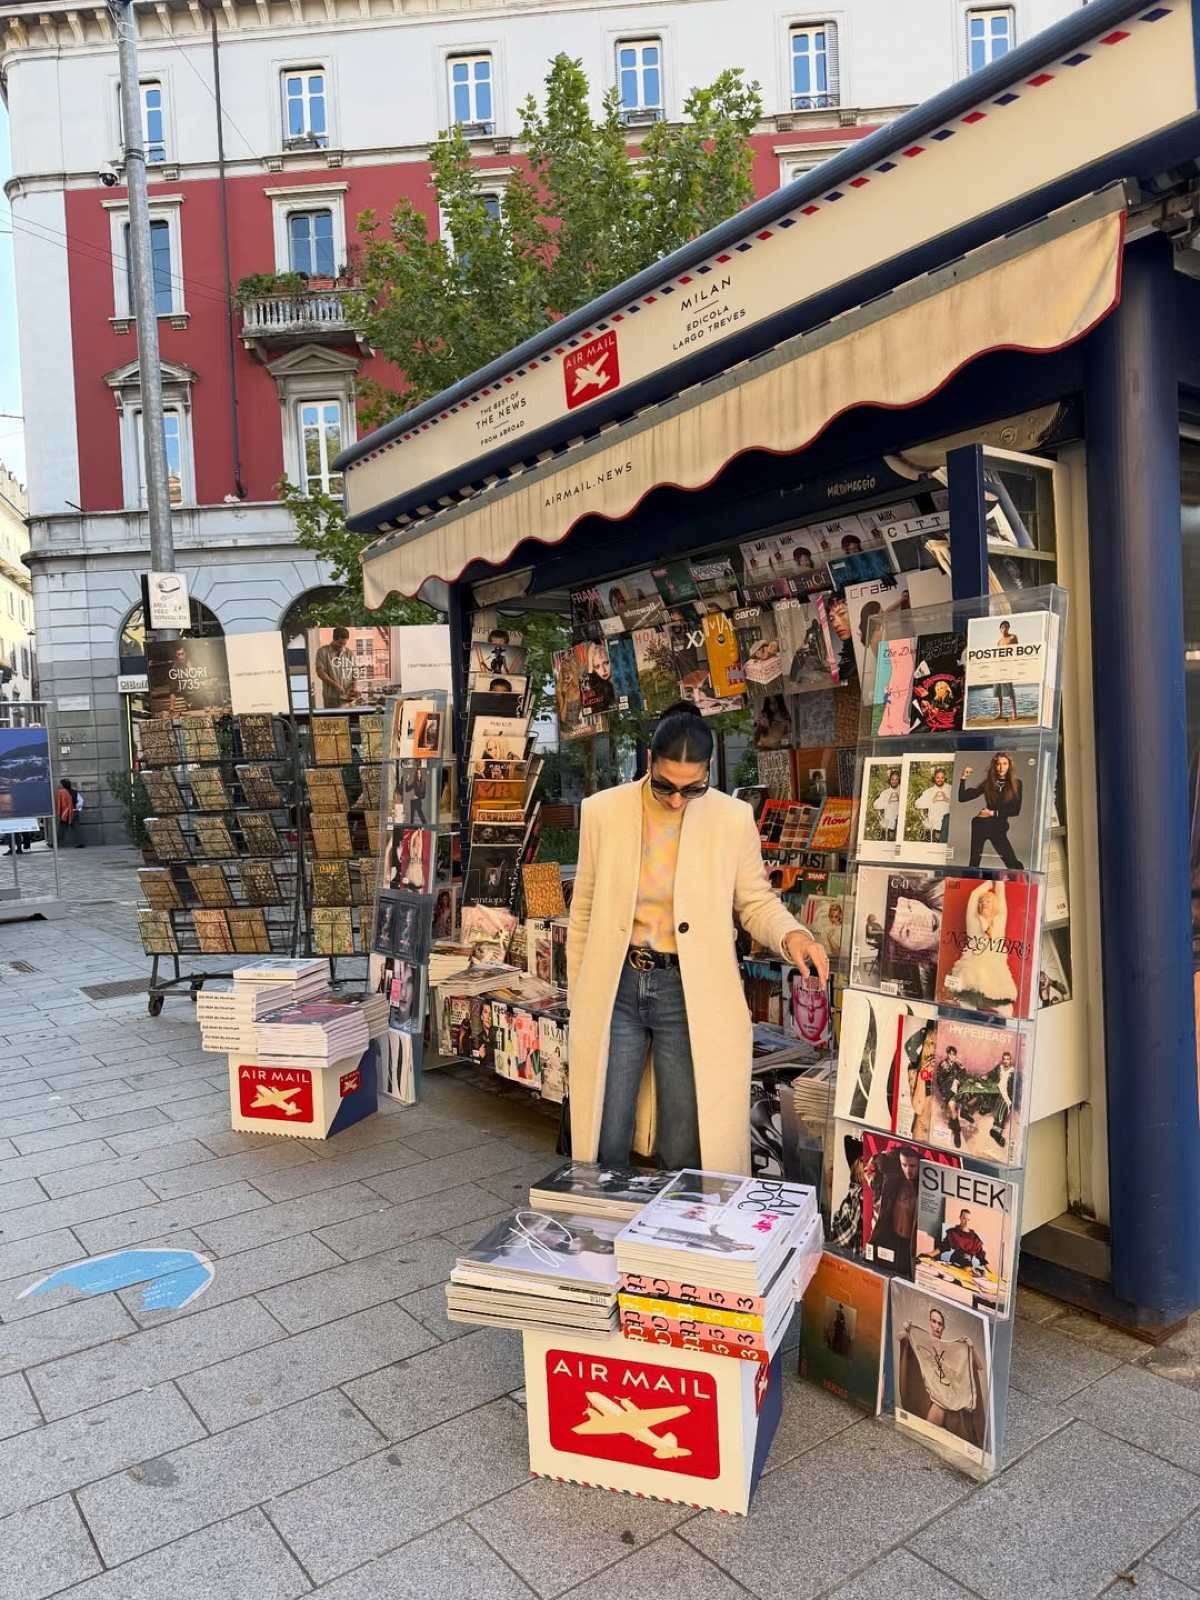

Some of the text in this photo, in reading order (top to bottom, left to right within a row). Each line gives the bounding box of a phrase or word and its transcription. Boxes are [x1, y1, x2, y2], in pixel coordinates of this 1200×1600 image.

[680, 275, 732, 311] MILAN
[672, 308, 747, 351] LARGO TREVES
[686, 305, 729, 332] EDICOLA
[565, 337, 615, 369] AIR MAIL
[475, 398, 527, 429] THE NEWS
[480, 433, 498, 446] FROM
[545, 461, 633, 507] AIRMAIL.NEWS
[968, 647, 1013, 661] POSTER
[1016, 643, 1042, 657] BOY
[168, 666, 208, 680] GINORI
[178, 678, 200, 692] 1735
[949, 1023, 1014, 1043] HYPEBEAST
[241, 1069, 310, 1083] AIR MAIL
[922, 1166, 1009, 1213] SLEEK
[552, 1358, 712, 1400] AIR MAIL
